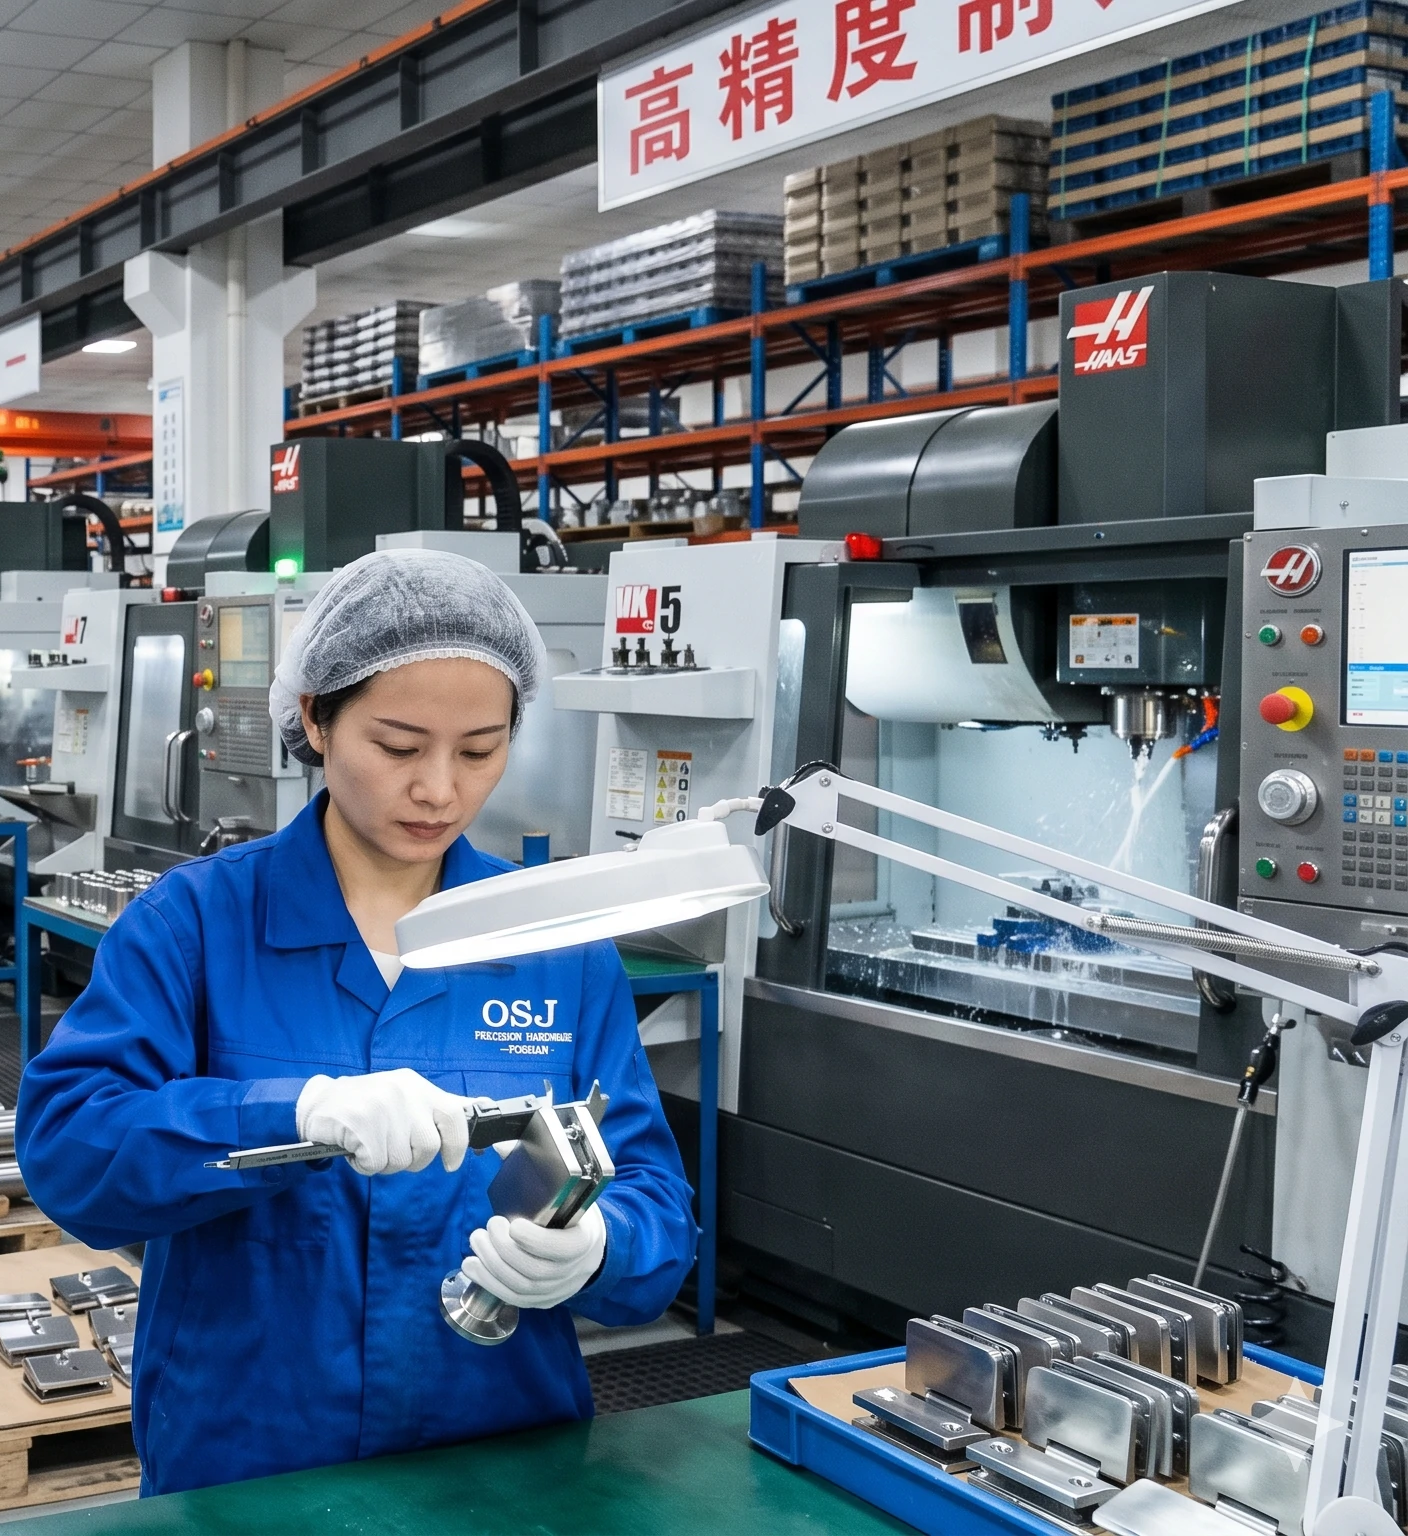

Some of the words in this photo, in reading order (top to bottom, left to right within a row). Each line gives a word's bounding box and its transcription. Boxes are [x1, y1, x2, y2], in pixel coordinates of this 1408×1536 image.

[626, 0, 1113, 175] 高精度
[1074, 343, 1147, 371] HAAS
[660, 585, 682, 634] 5
[79, 616, 88, 644] 7
[482, 999, 558, 1028] OSJ
